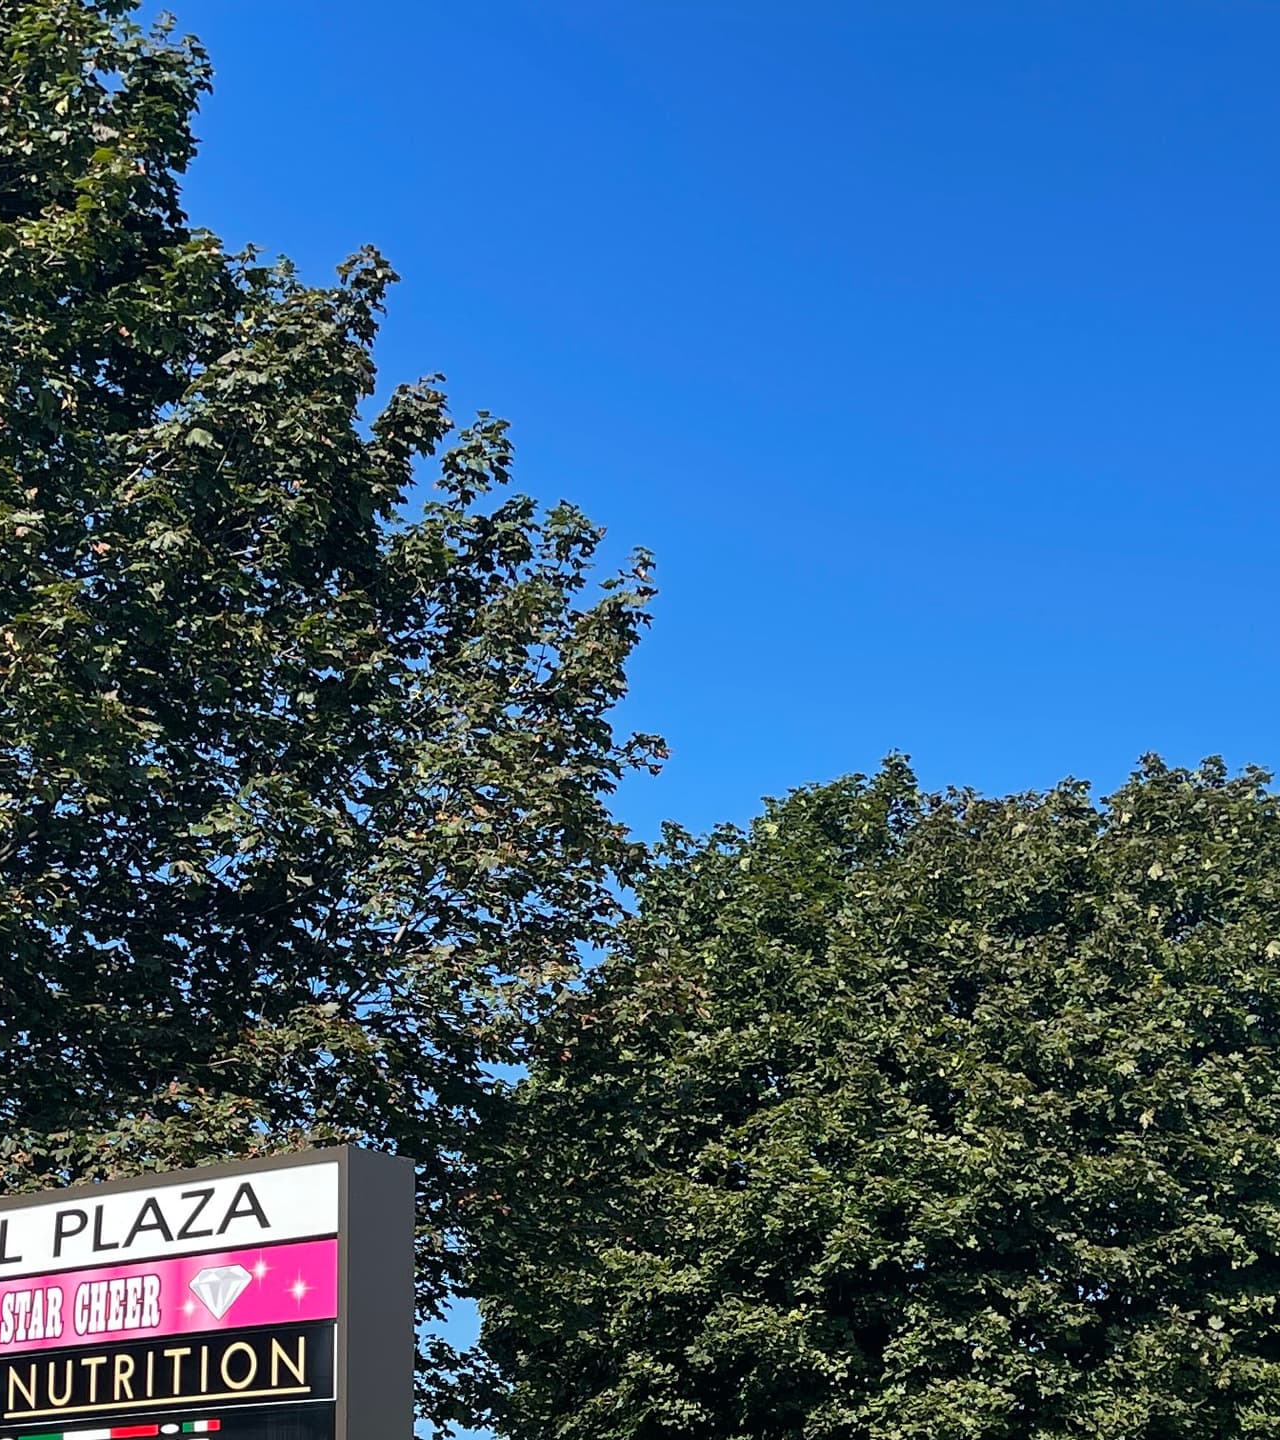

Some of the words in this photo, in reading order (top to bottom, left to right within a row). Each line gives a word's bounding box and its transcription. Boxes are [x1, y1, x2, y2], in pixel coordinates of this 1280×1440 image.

[53, 1182, 271, 1258] PLAZA
[0, 1286, 64, 1345] STAR
[73, 1274, 162, 1336] CHEER
[8, 1336, 306, 1410] NUTRITION
